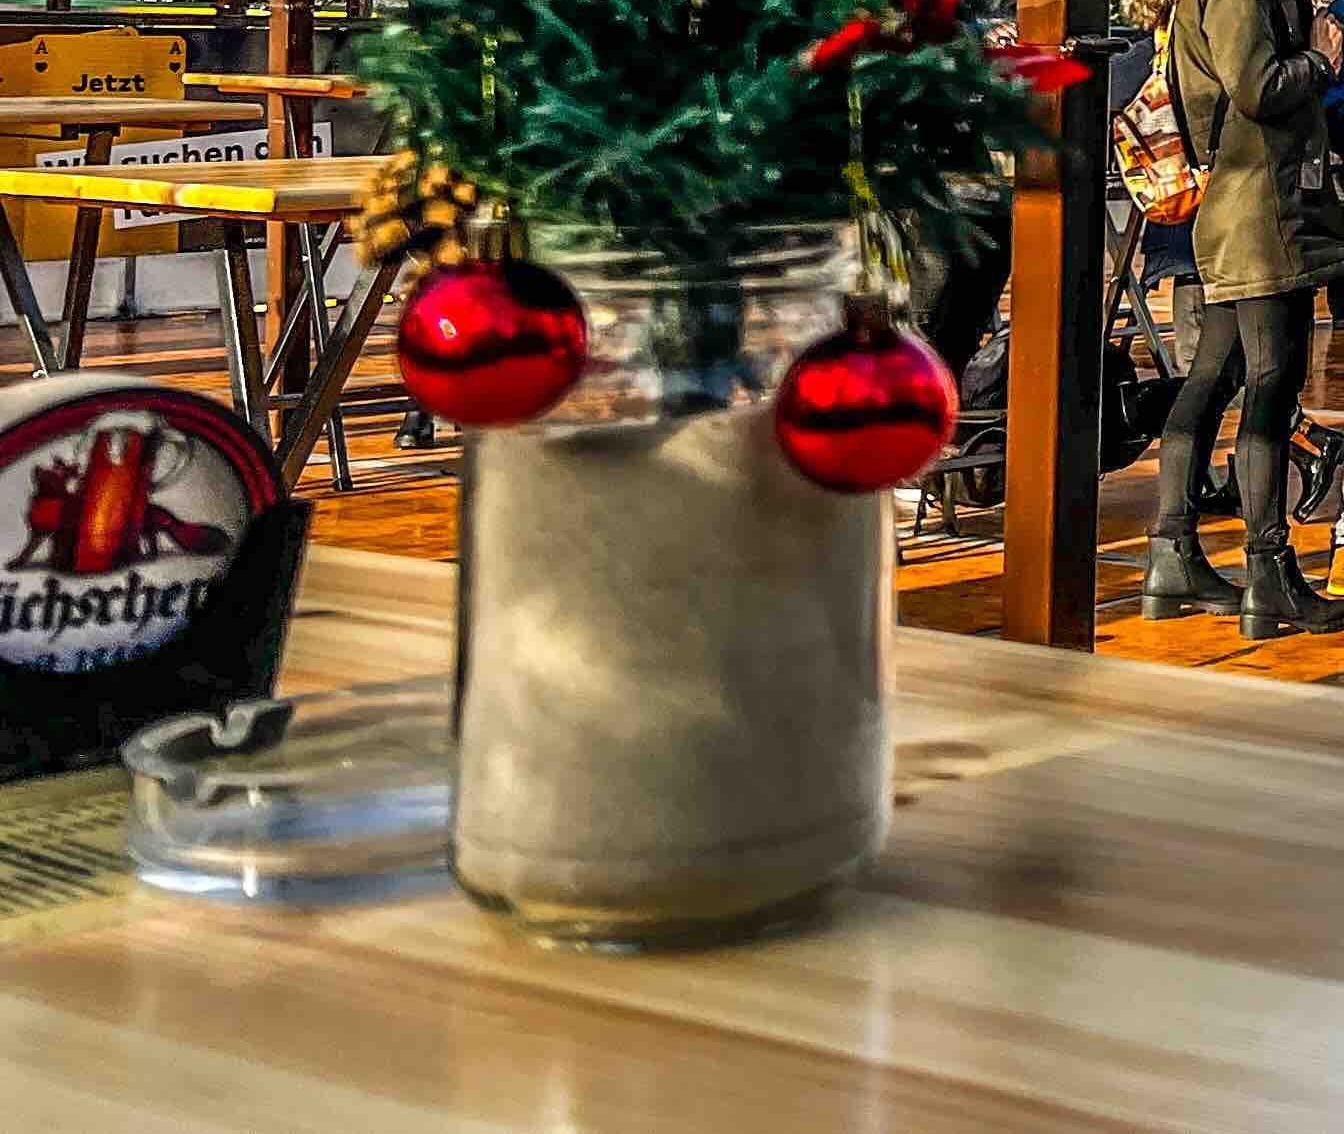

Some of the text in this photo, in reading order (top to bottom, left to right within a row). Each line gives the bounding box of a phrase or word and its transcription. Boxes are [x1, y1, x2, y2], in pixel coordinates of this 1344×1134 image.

[35, 40, 49, 54] A
[169, 41, 182, 55] A
[72, 73, 145, 93] Jetzt
